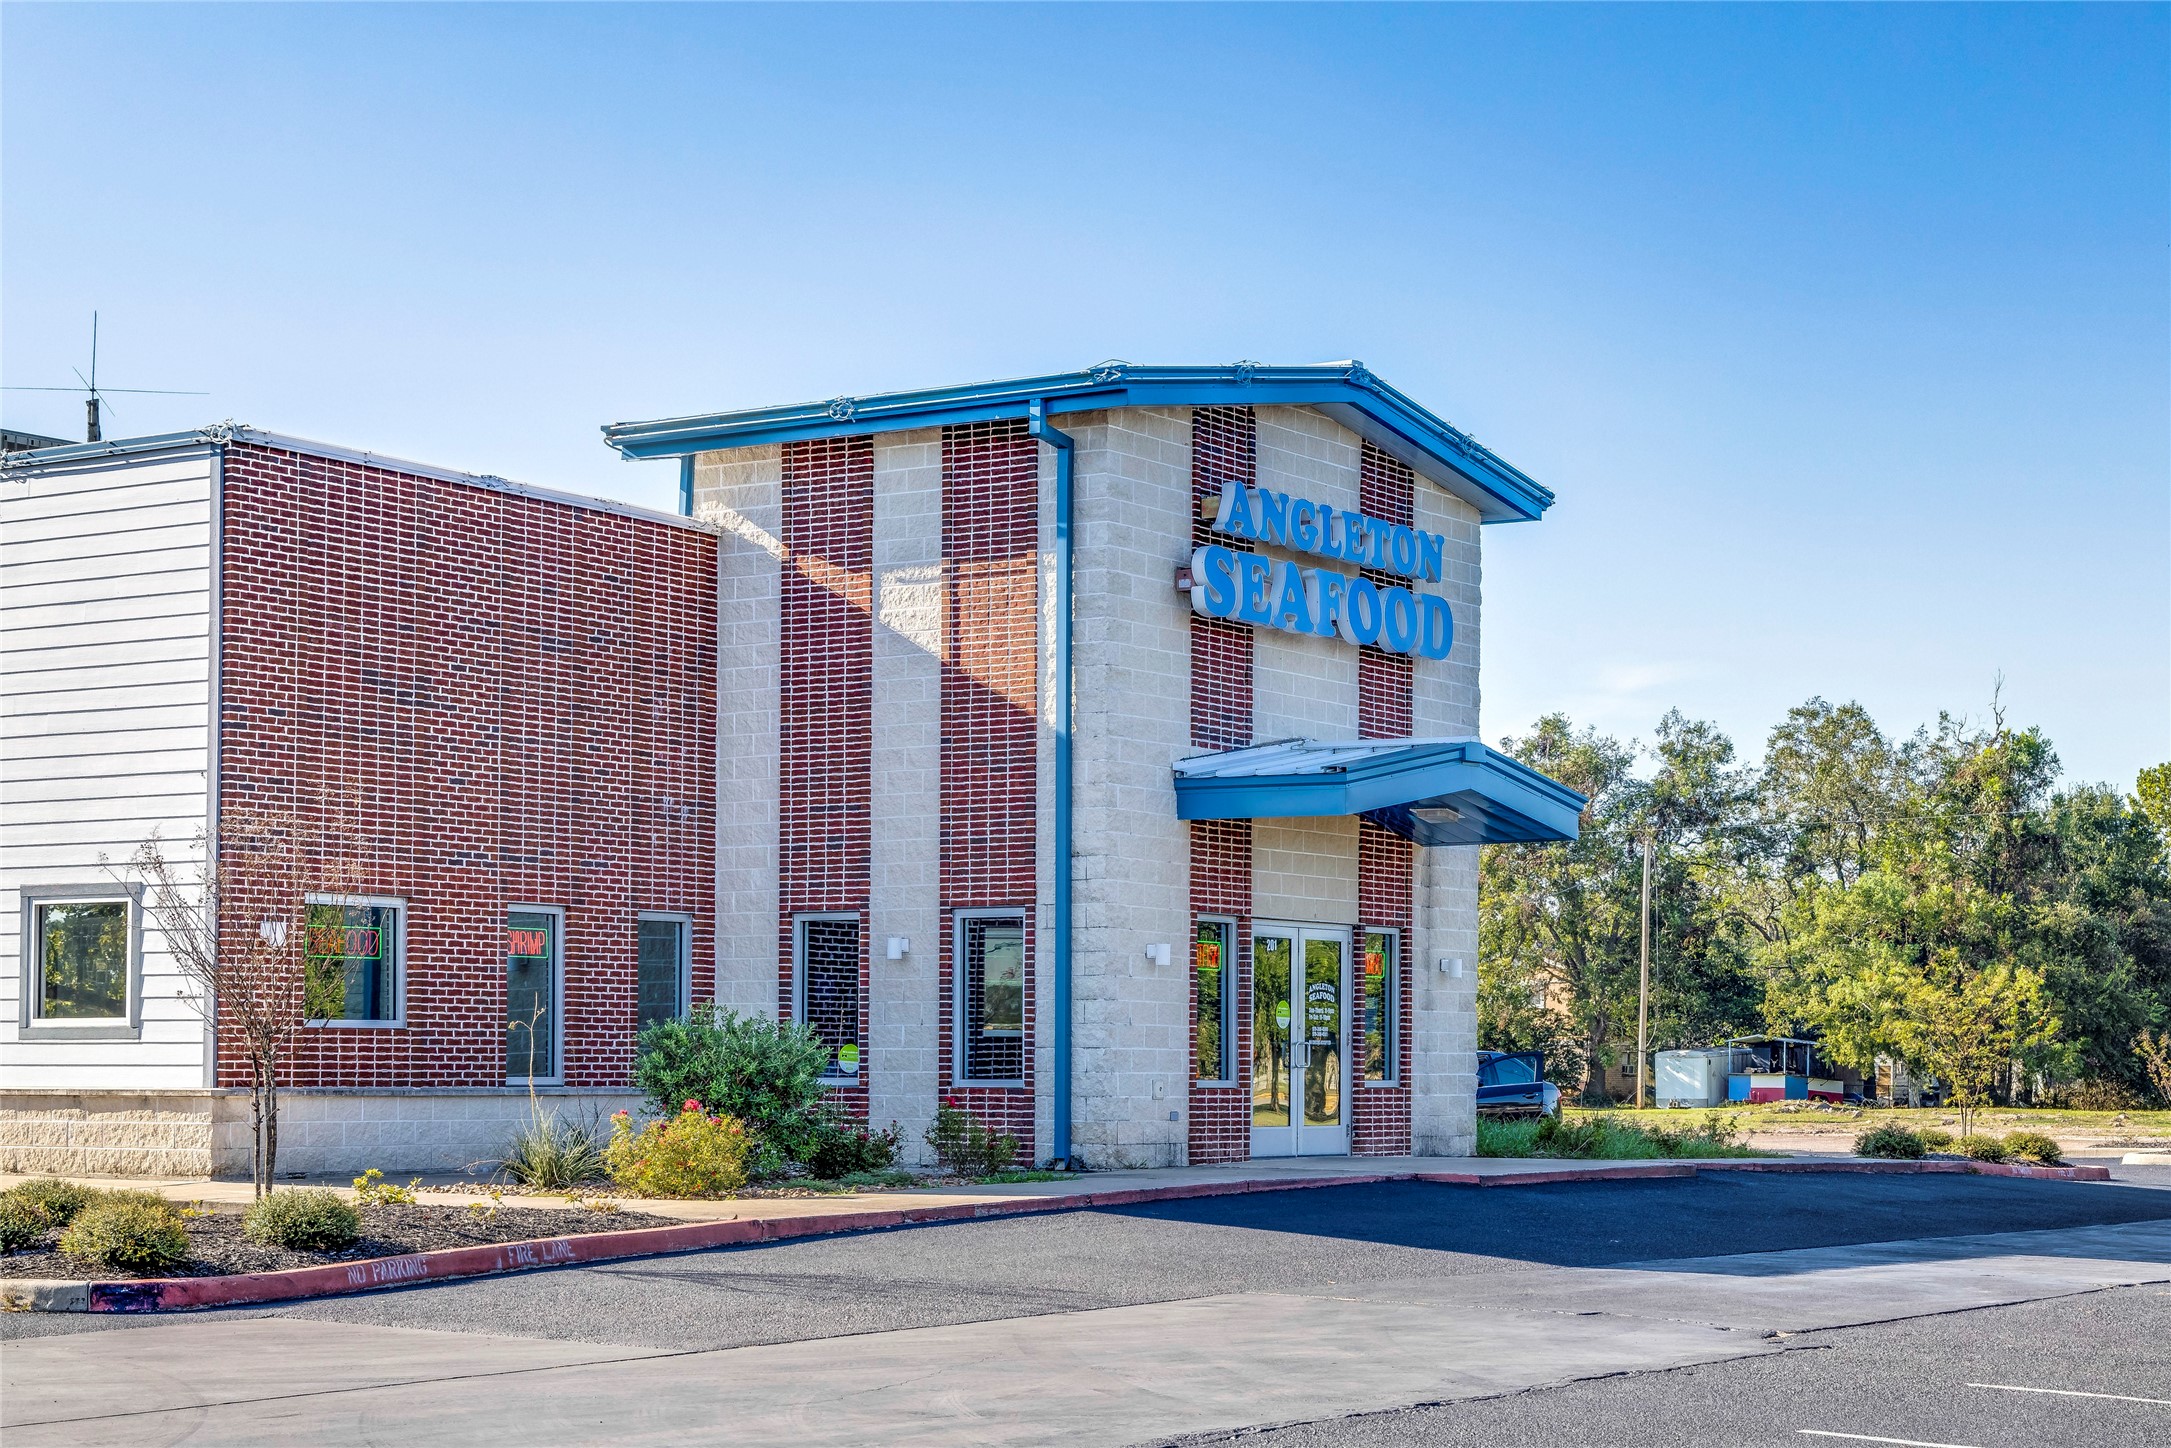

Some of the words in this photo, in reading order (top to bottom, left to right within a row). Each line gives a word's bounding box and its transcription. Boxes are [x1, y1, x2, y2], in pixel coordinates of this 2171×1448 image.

[1214, 481, 1445, 583] ANGLETON
[1192, 545, 1454, 661] SEAFOOD
[308, 928, 379, 956] SEAFOOD
[507, 930, 545, 955] SHRIMP
[1266, 939, 1277, 951] 201
[1308, 982, 1335, 993] ANGLETON
[1308, 991, 1335, 1003] SEAFOOD
[507, 1243, 538, 1264] FIRE
[542, 1239, 576, 1259] LANE
[347, 1266, 366, 1284] NO
[371, 1257, 428, 1282] PARKING
